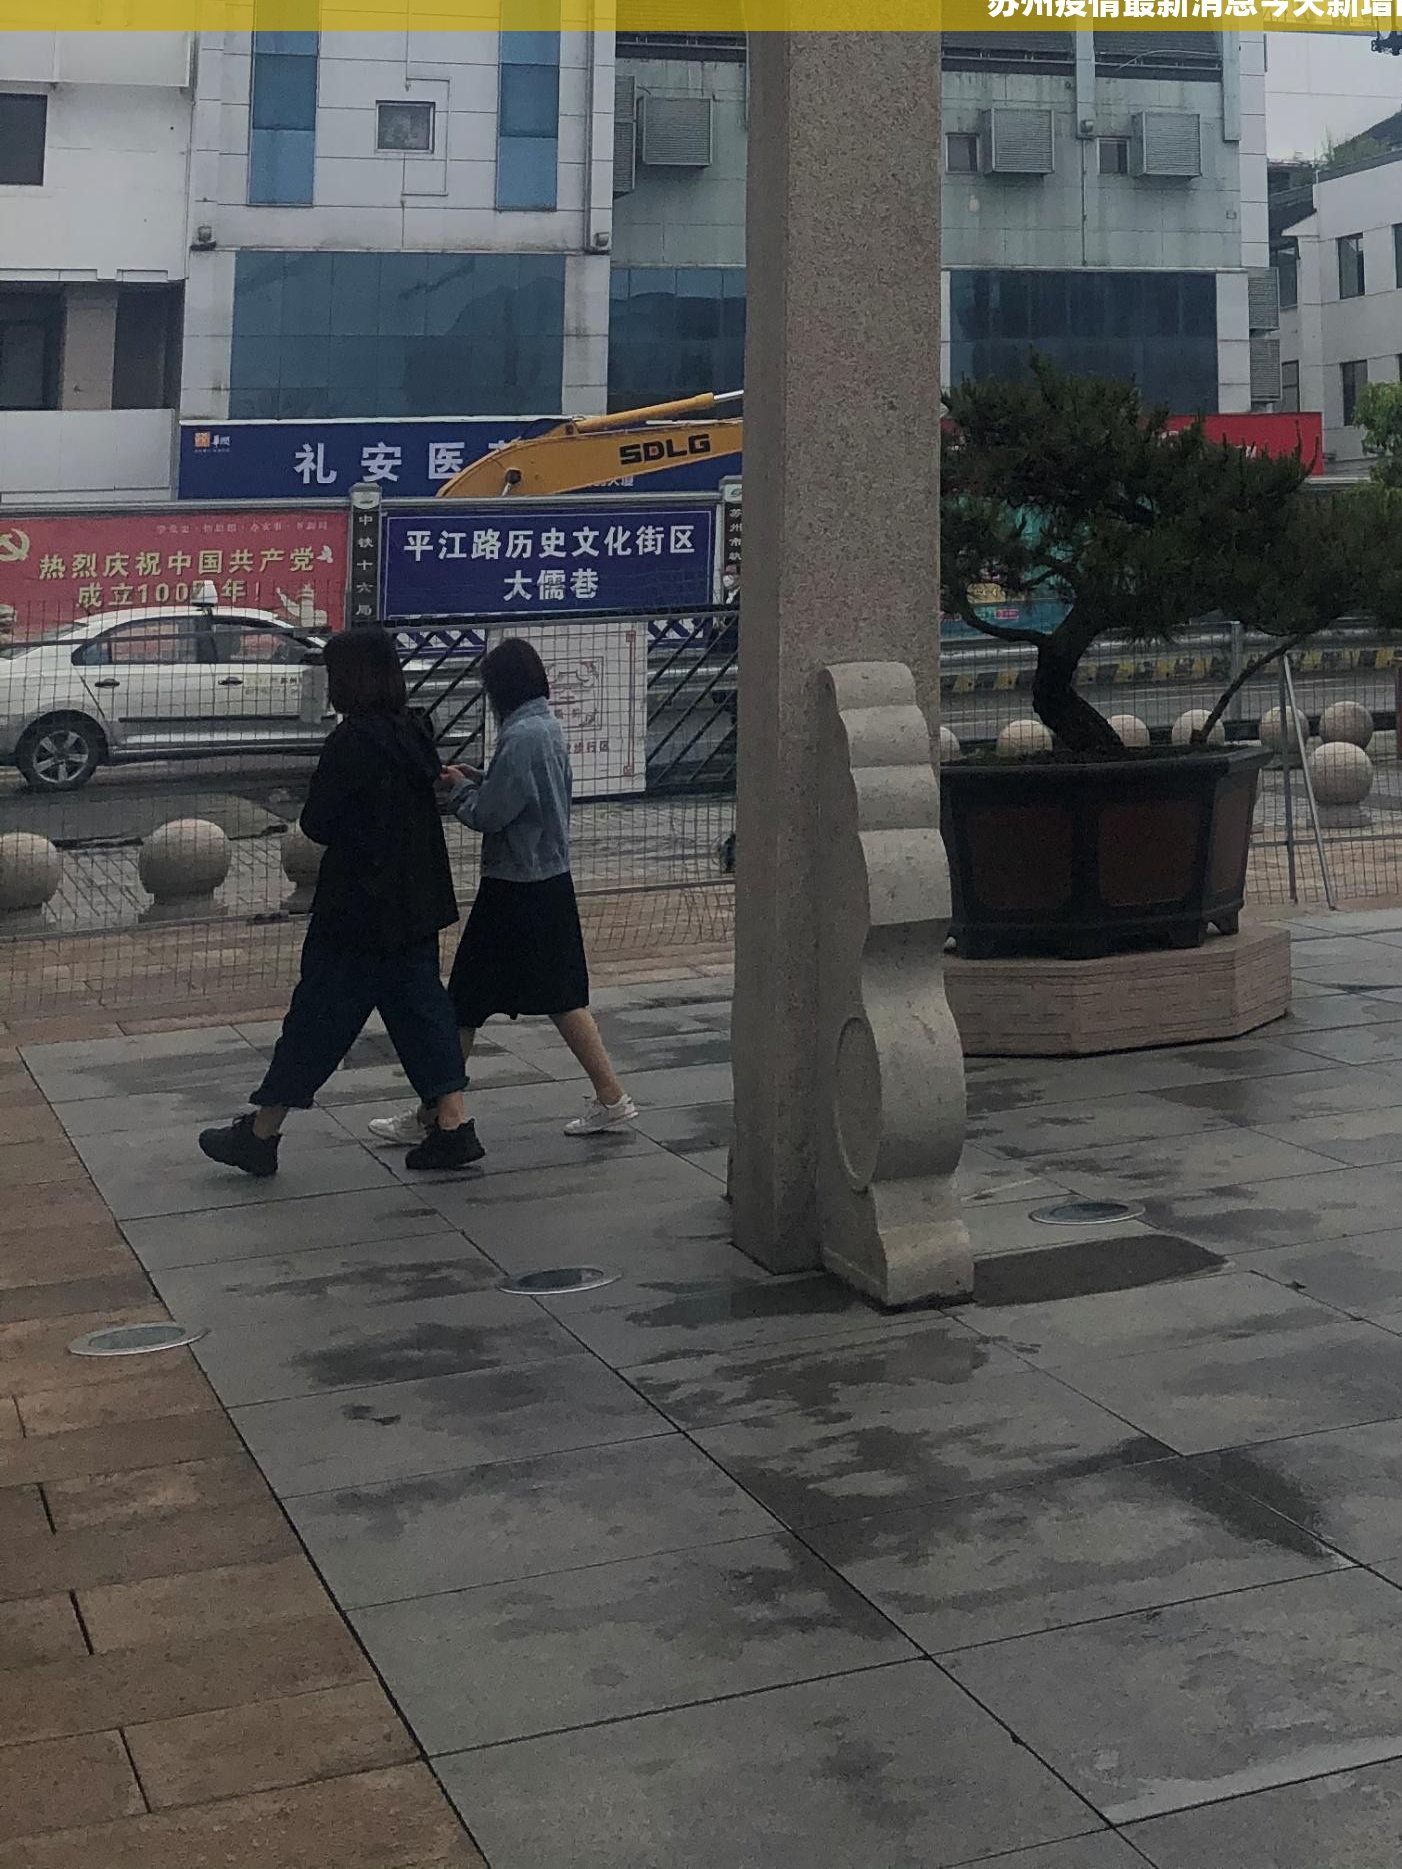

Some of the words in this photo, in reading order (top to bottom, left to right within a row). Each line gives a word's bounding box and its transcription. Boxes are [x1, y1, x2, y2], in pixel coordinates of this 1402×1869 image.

[294, 438, 521, 484] 礼安医
[619, 433, 711, 465] SDLG
[403, 525, 695, 562] 平江路历史文化街区
[39, 546, 314, 580] 热烈庆祝中国共产党
[356, 514, 374, 616] 中铁十六局
[503, 568, 599, 601] 大儒巷
[567, 740, 609, 754] 步行区
